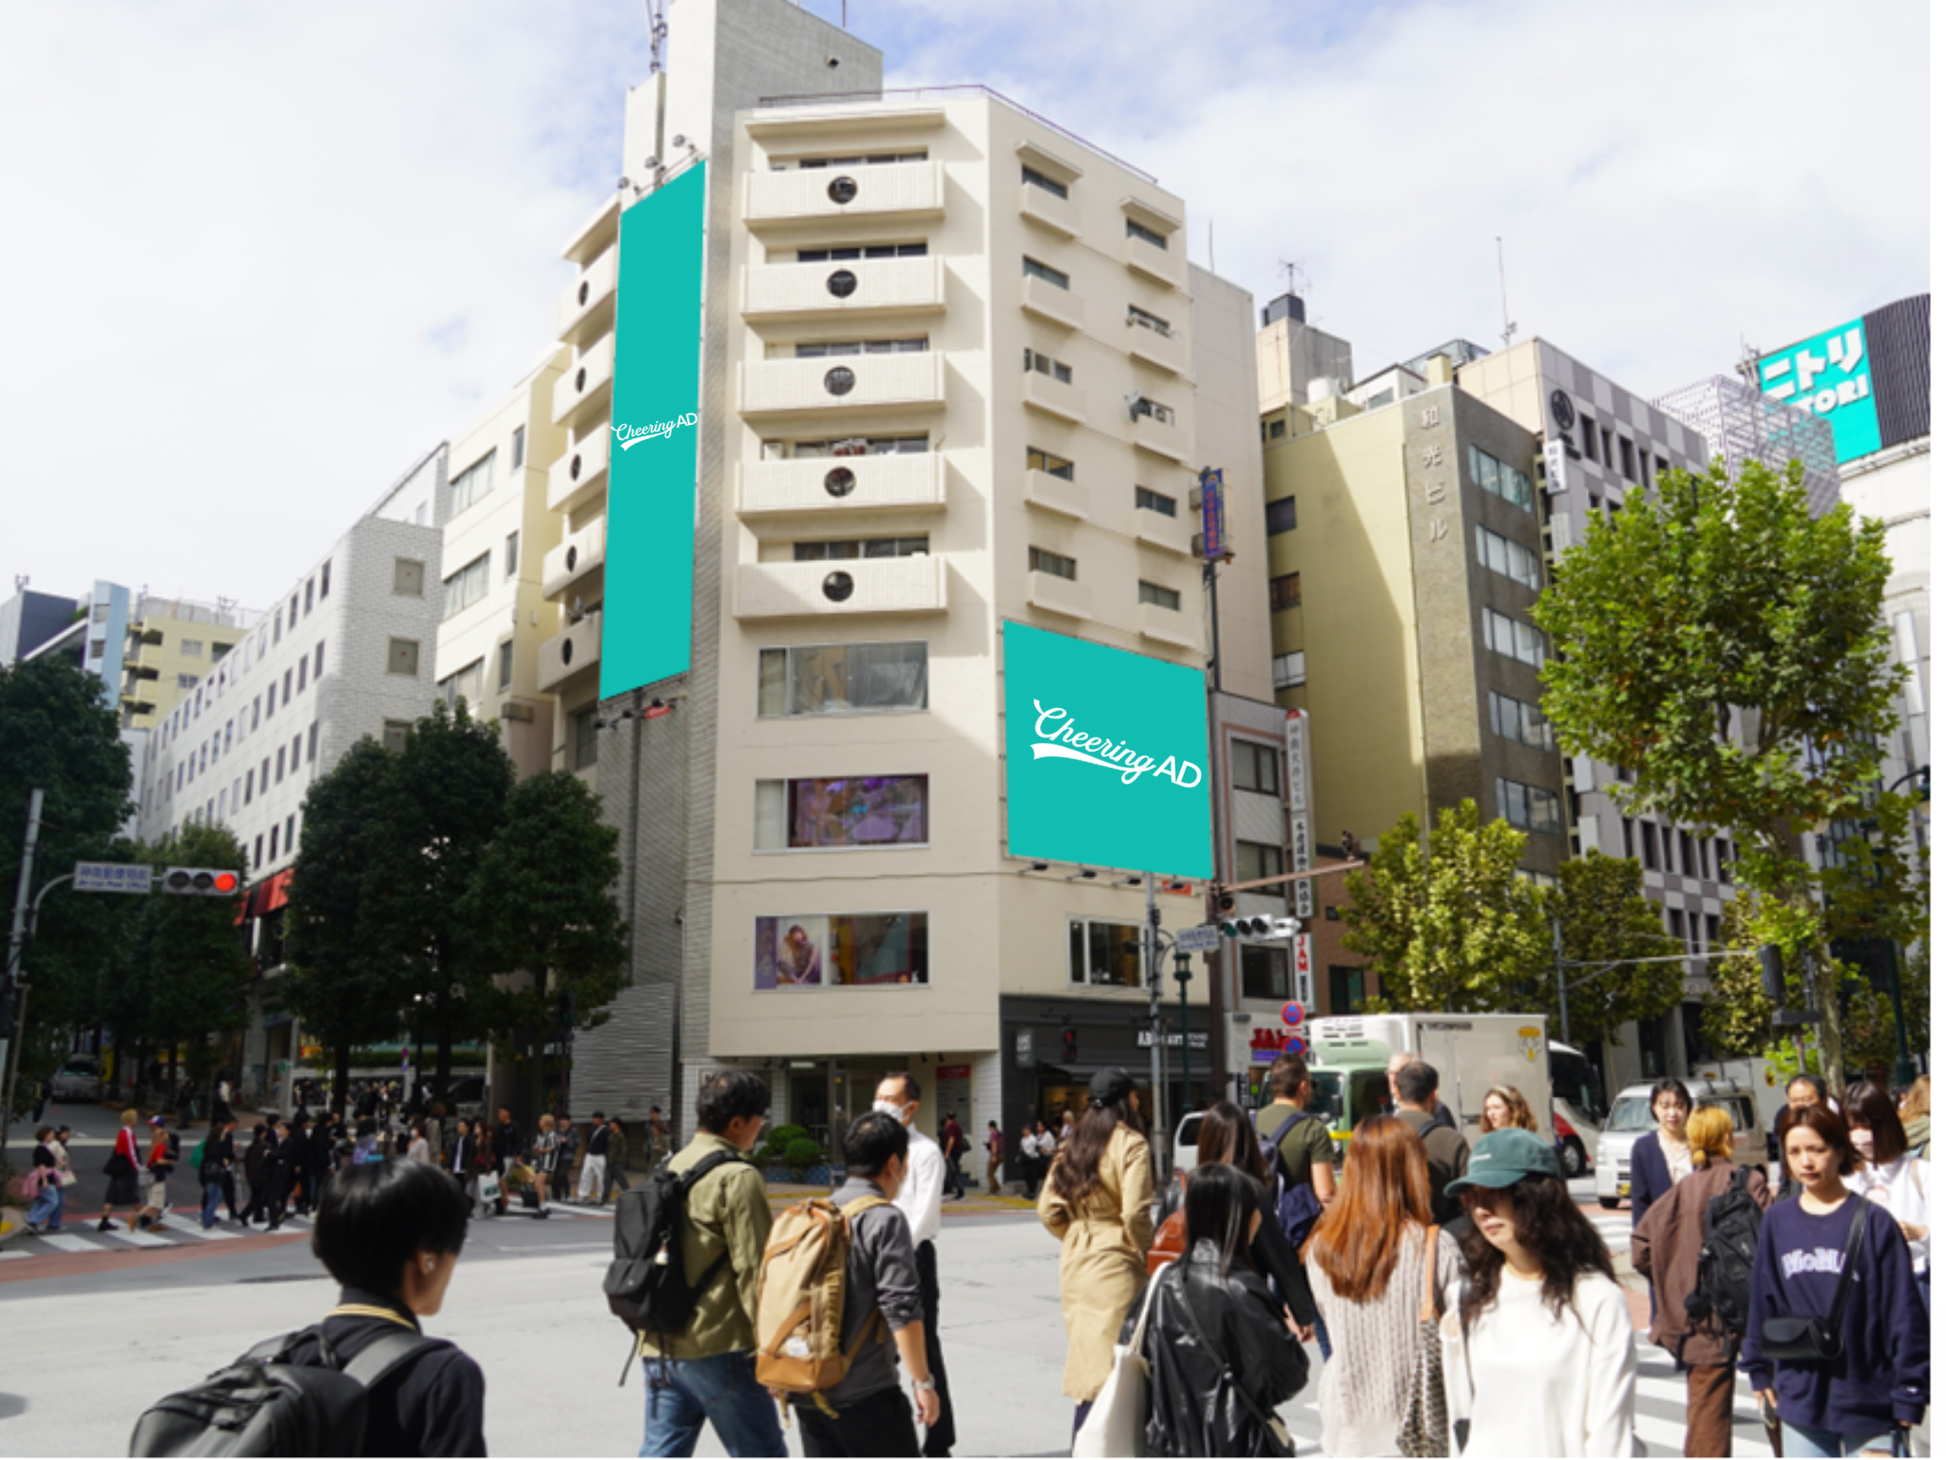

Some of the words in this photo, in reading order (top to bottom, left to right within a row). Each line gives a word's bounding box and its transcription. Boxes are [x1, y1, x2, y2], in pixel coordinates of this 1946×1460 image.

[1763, 327, 1864, 400] ニトリ
[610, 421, 676, 444] Cheering
[676, 412, 698, 428] AD
[1421, 405, 1449, 543] 和光ビル
[1032, 698, 1156, 785] Cheering
[1152, 755, 1202, 788] AD
[1296, 935, 1310, 972] JAM
